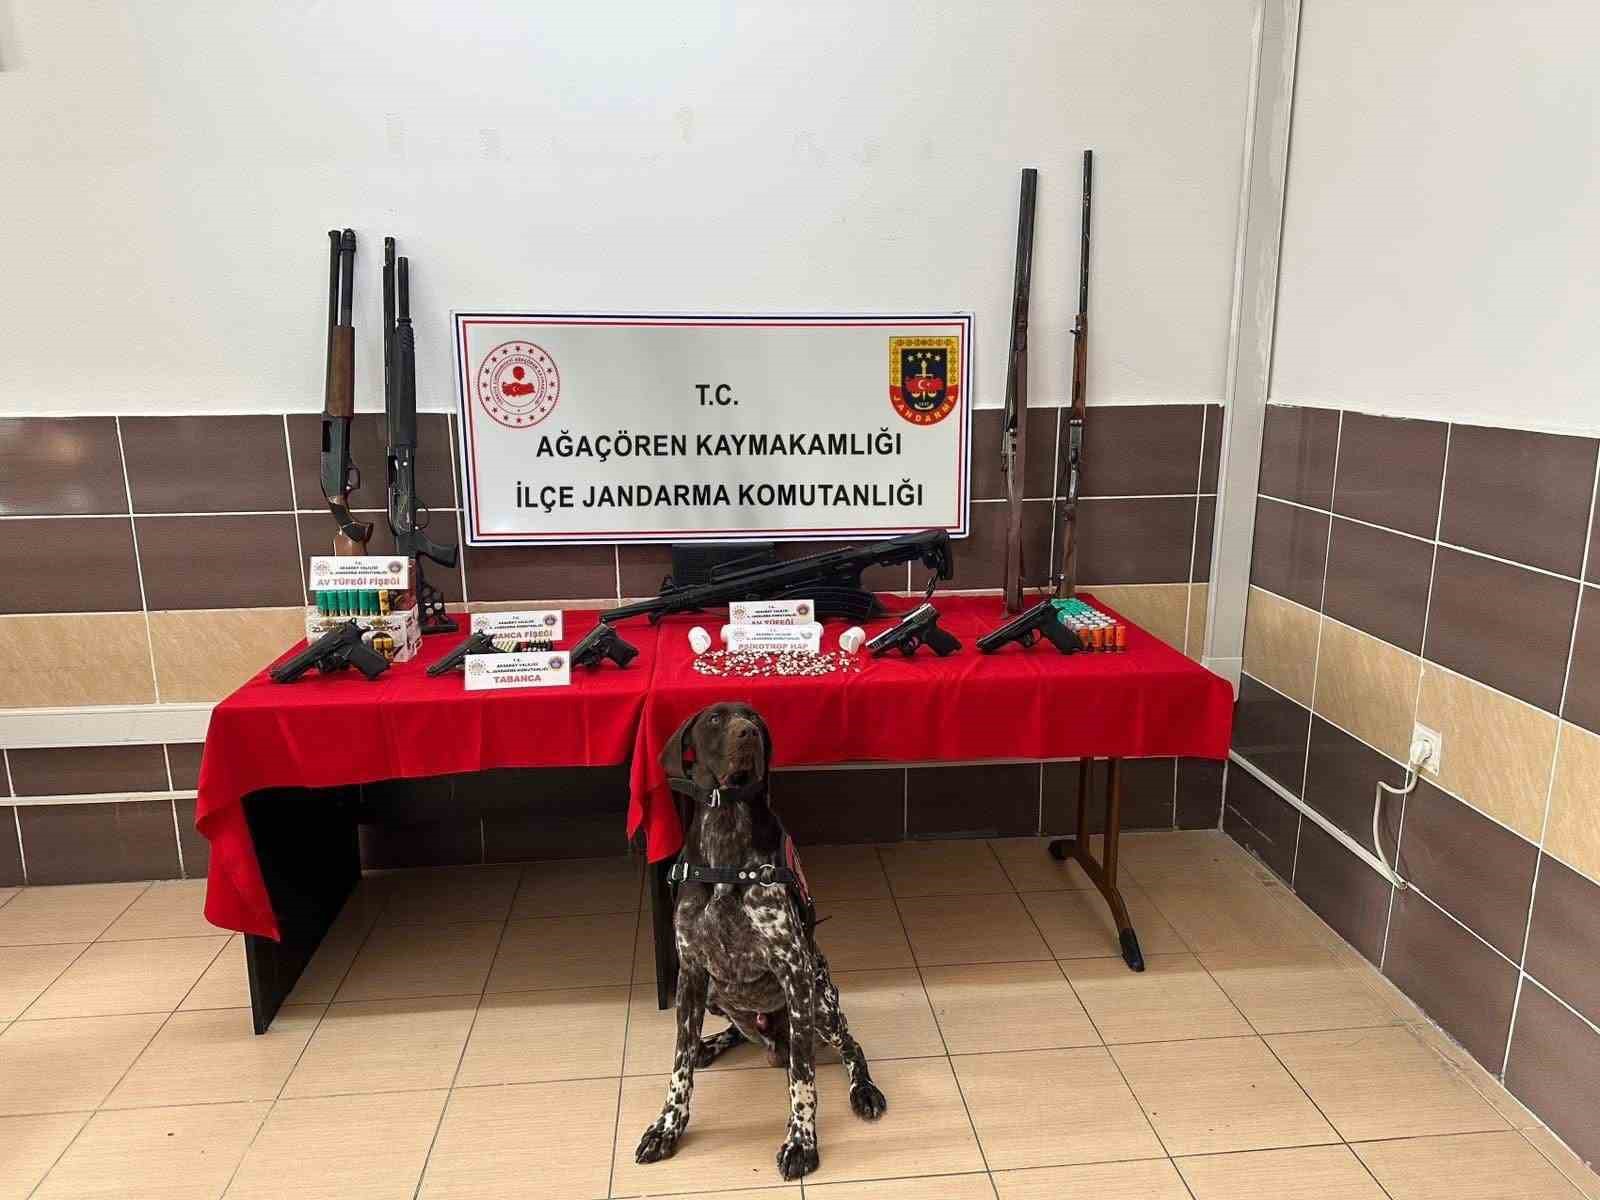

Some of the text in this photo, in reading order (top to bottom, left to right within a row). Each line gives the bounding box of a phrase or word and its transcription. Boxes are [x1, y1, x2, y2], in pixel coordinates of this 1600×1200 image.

[695, 384, 739, 406] T.C.
[893, 394, 955, 423] JANDARMA
[536, 427, 902, 464] AĞAÇÖREN KAYMAKAMLIĞI
[517, 478, 923, 513] İLÇE JANDARMA KOMUTANLIĞI
[494, 673, 542, 684] TABANCA
